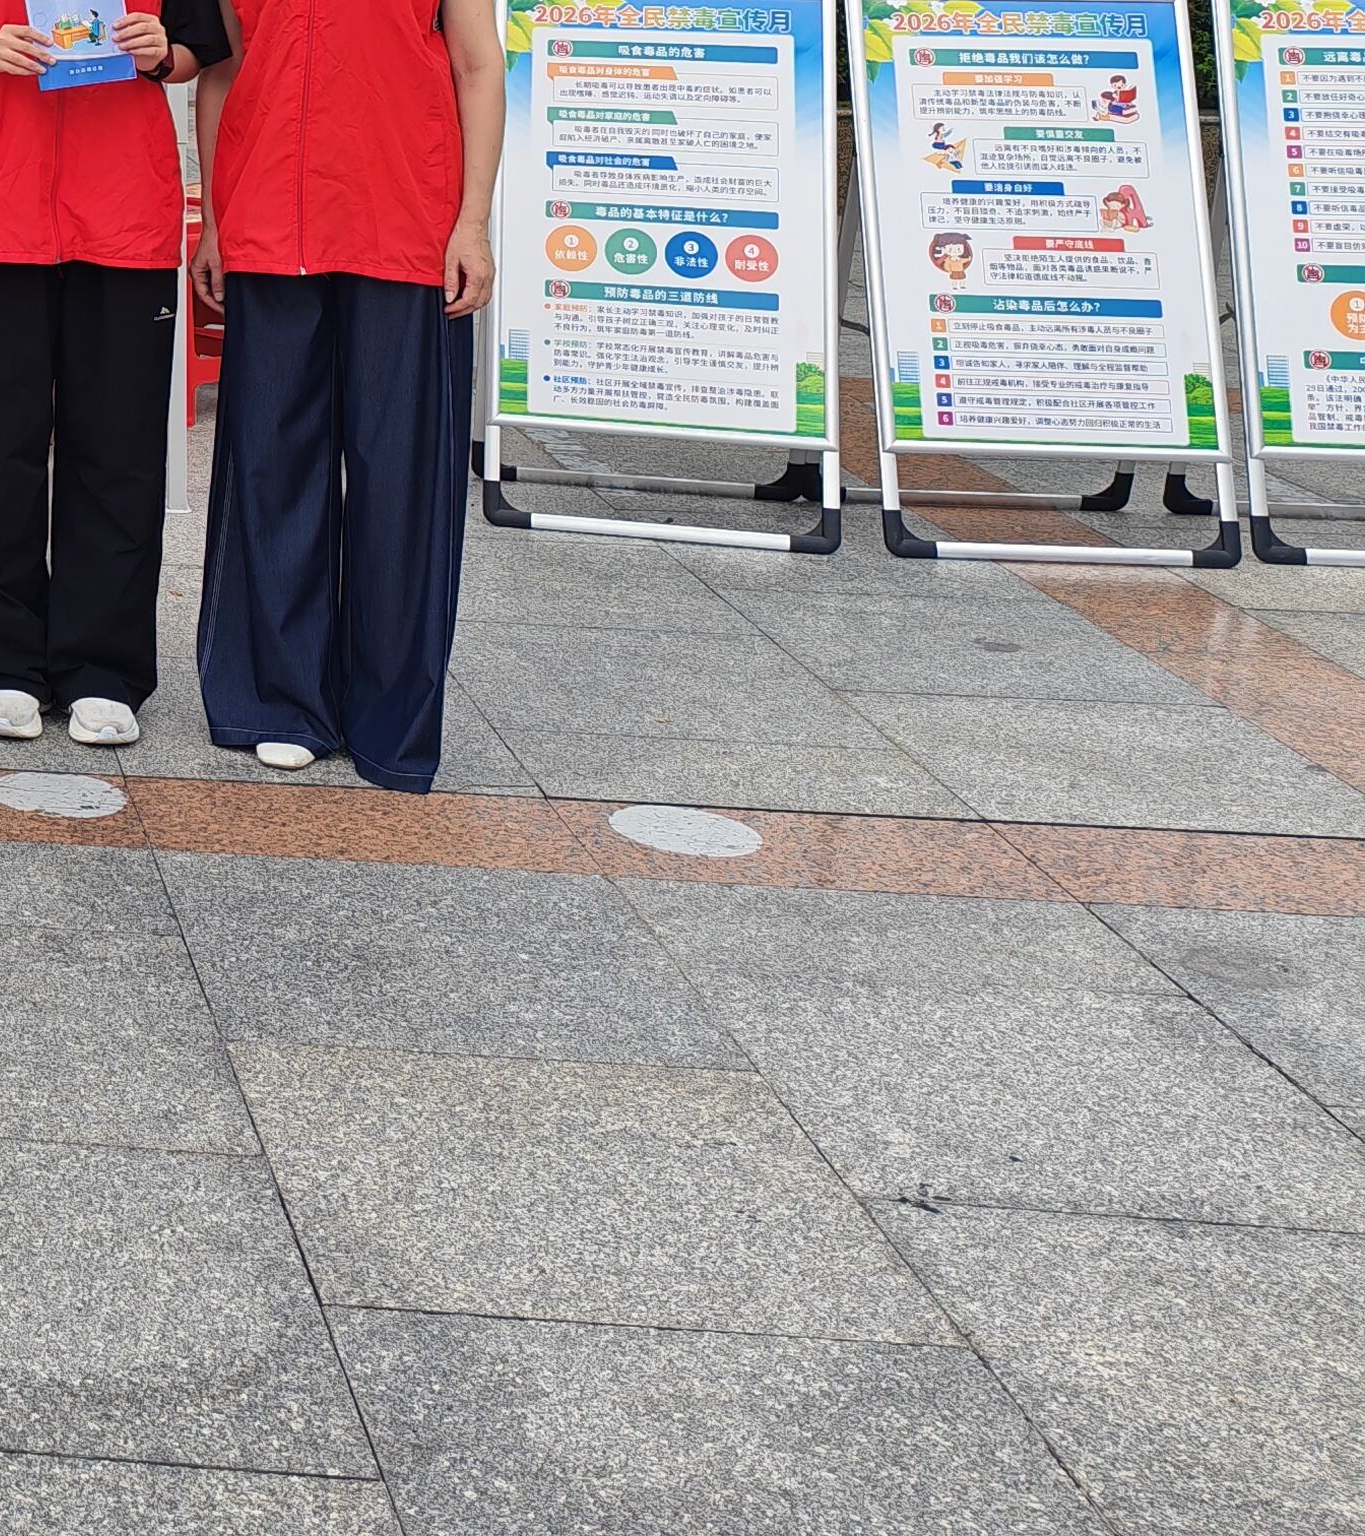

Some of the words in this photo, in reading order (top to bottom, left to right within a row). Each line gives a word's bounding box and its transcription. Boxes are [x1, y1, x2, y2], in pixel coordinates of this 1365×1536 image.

[534, 5, 791, 32] 2026年全民禁毒宣传月
[892, 11, 1148, 37] 2026年全民禁毒宣传月
[1261, 10, 1365, 33] 2026年全
[618, 45, 705, 58] 吸食毒品的危害
[1323, 51, 1365, 63] 远离毒
[959, 52, 1090, 65] 拒绝毒品我们该怎么做?
[1302, 74, 1365, 83] 不要因为遇到不
[558, 110, 650, 122] 吸食毒品对家庭的危害
[558, 154, 650, 167] 吸食毒品对社会的危害
[1311, 166, 1365, 175] 不要听信吸毒
[984, 182, 1033, 192] 要洁身自好
[595, 206, 728, 223] 毒品的基本特征是什么?
[555, 250, 589, 261] 依赖性
[614, 253, 649, 264] 危害性
[674, 256, 709, 268] 非法性
[734, 259, 769, 272] 耐受性
[604, 286, 718, 304] 预防毒品的三道防线
[992, 299, 1100, 313] 沾染毒品后怎么办?
